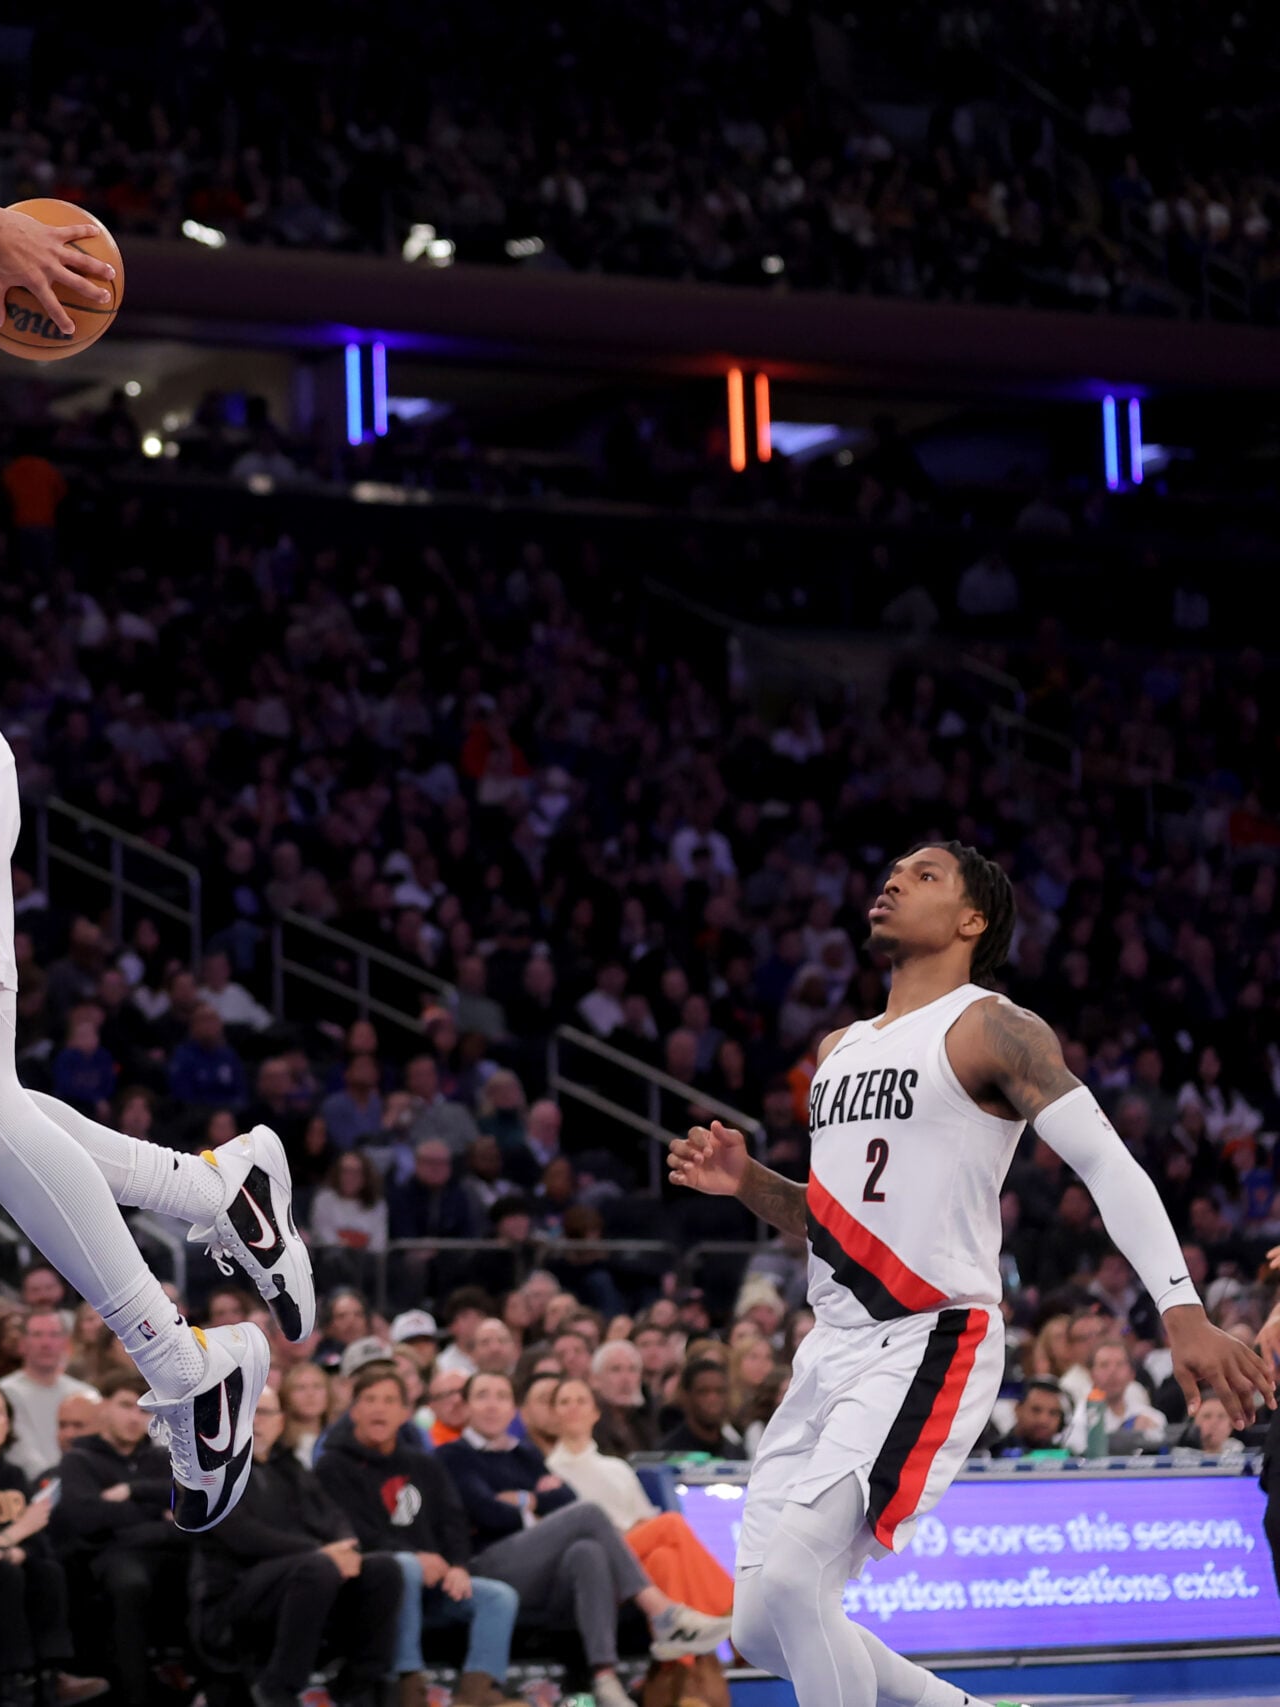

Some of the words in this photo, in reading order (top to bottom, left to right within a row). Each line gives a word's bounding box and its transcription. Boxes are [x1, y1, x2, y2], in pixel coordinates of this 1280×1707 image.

[809, 1068, 918, 1133] BLAZERS
[863, 1138, 889, 1202] 2
[952, 1524, 1065, 1556] scores
[1067, 1512, 1130, 1552] this
[1132, 1519, 1255, 1554] season,
[969, 1565, 1171, 1607] medications
[1173, 1560, 1259, 1600] exist.
